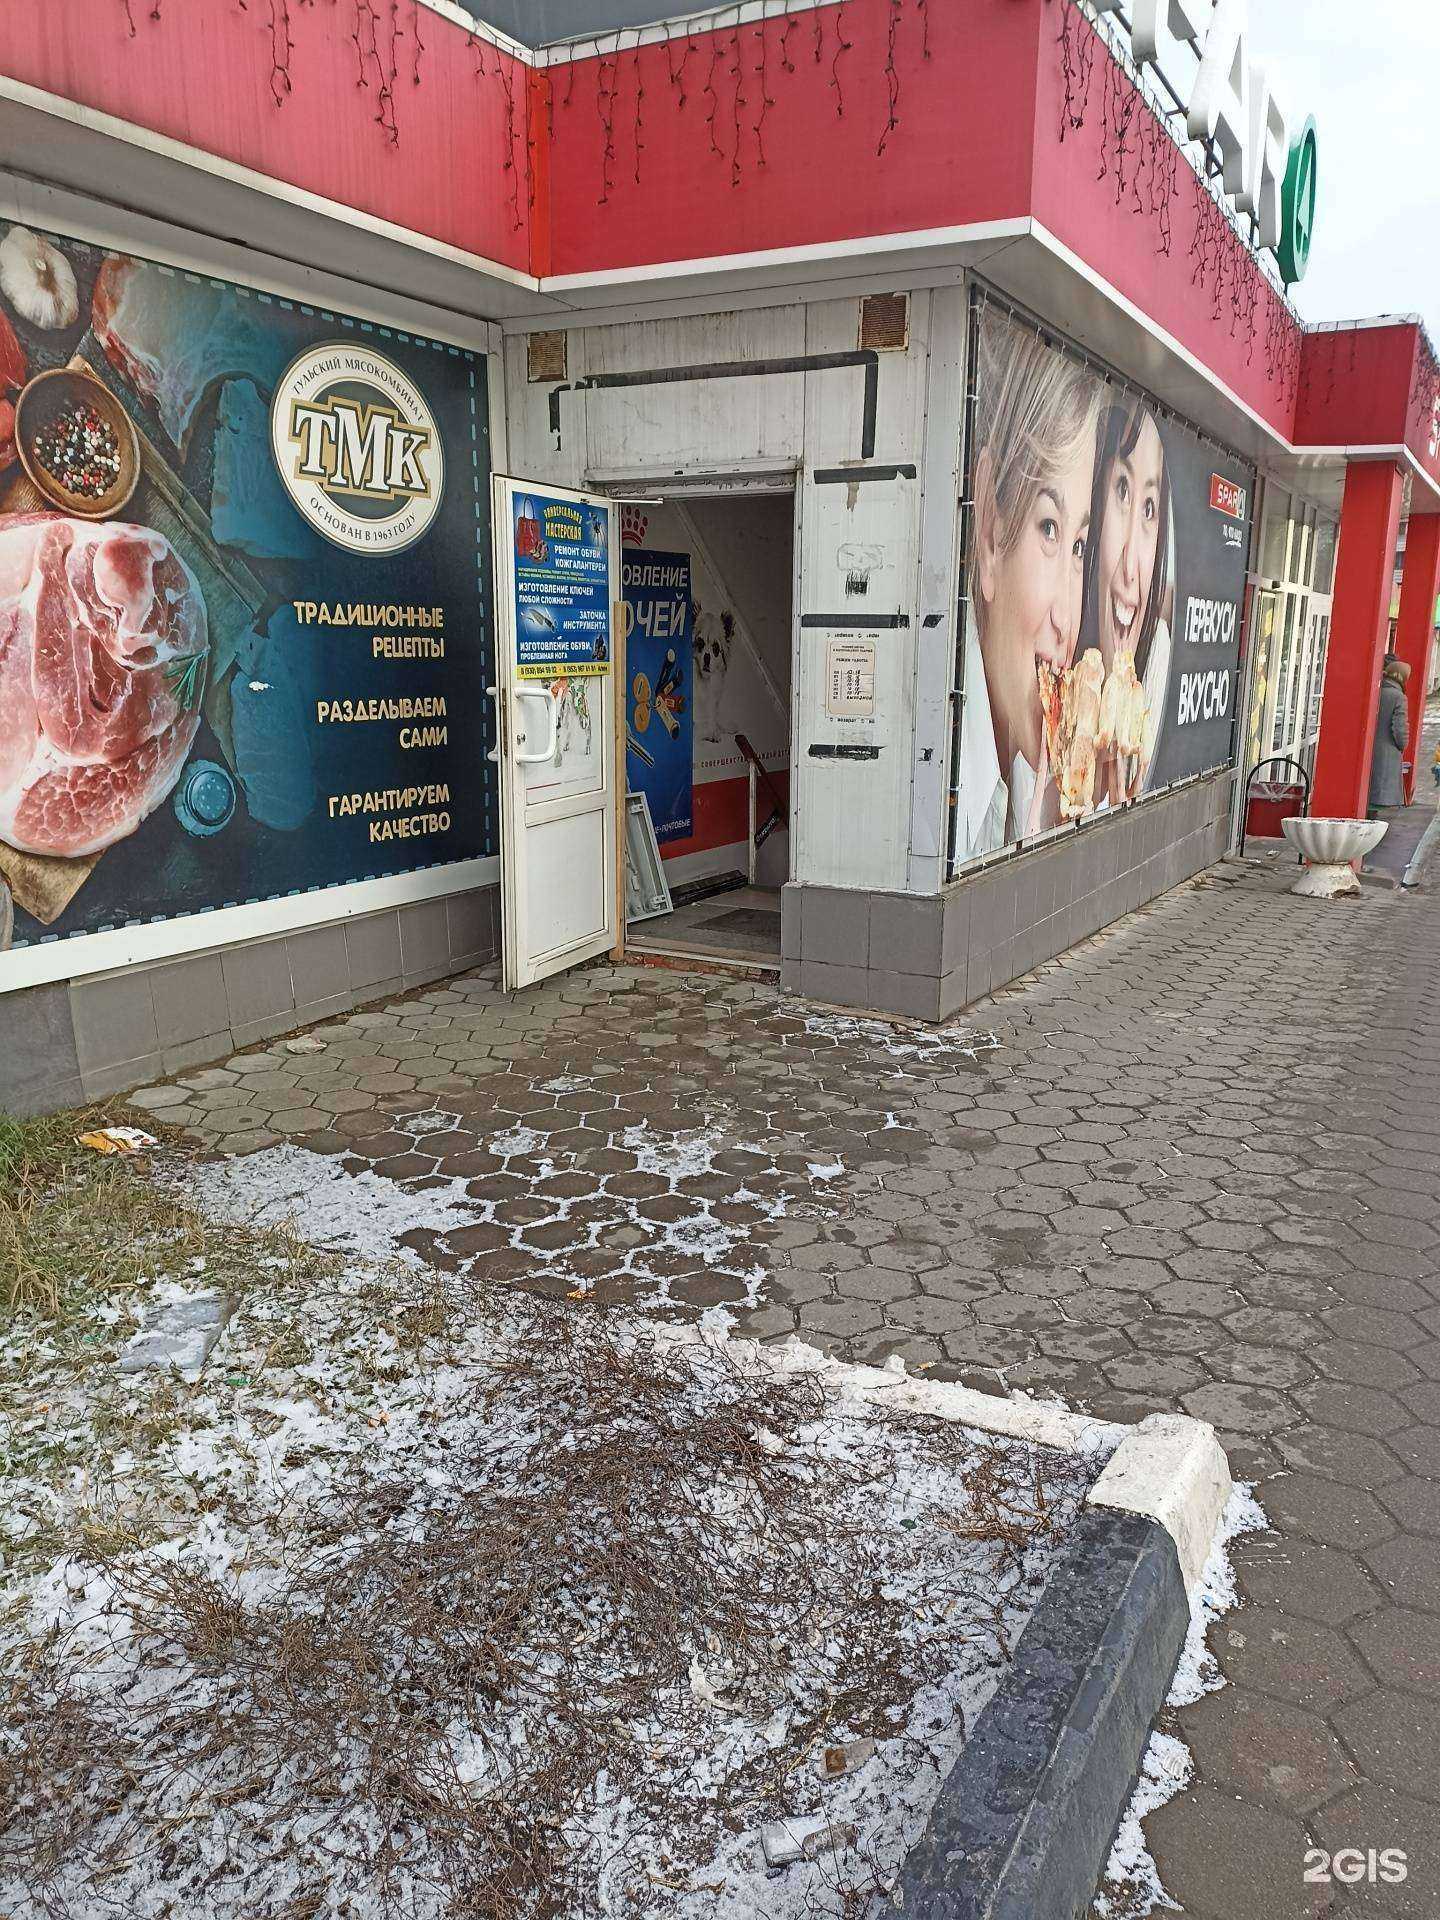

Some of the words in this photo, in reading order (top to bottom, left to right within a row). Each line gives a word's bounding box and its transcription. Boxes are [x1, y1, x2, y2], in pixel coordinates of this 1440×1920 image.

[293, 356, 341, 395] ТУЛЬСКИЙ
[345, 357, 424, 422] МЯСОКОМБИНАТ
[295, 406, 426, 490] ТМК
[1217, 483, 1239, 514] SPAR
[310, 496, 363, 541] ОСНОВАН
[365, 531, 371, 541] В
[373, 528, 393, 542] 1963
[394, 512, 416, 536] ГОДУ
[545, 521, 582, 540] МАСТЕРСКАЯ
[554, 545, 579, 556] РЕМОНТ
[622, 564, 688, 587] ОВЛЕНИЕ
[518, 582, 569, 595] ИЗГОТОВЛЕНИЕ
[569, 585, 594, 596] КЛЮЧЕЙ
[518, 594, 540, 603] ЛЮБОЙ
[540, 595, 574, 605] СЛОЖНОСТИ
[293, 601, 444, 628] ТРАДИЦИОННЫЕ
[563, 620, 606, 630] ИНСТРУМЕНТА
[579, 610, 606, 620] ЗАТОЧКА
[1184, 596, 1236, 643] ПЕРЕКУСИ
[372, 636, 445, 658] РЕЦЕПТЫ
[520, 641, 570, 651] ИЗГОТОВЛЕНИЕ
[1177, 669, 1230, 726] ВКУСНО
[317, 697, 447, 723] РАЗДЕЛЫВАЕМ
[399, 726, 448, 749] САМИ
[328, 783, 450, 818] ГАРАНТИРУЕМ
[369, 811, 451, 843] КАЧЕСТВО
[655, 818, 691, 835] Е-ПОЧТОВЫЕ
